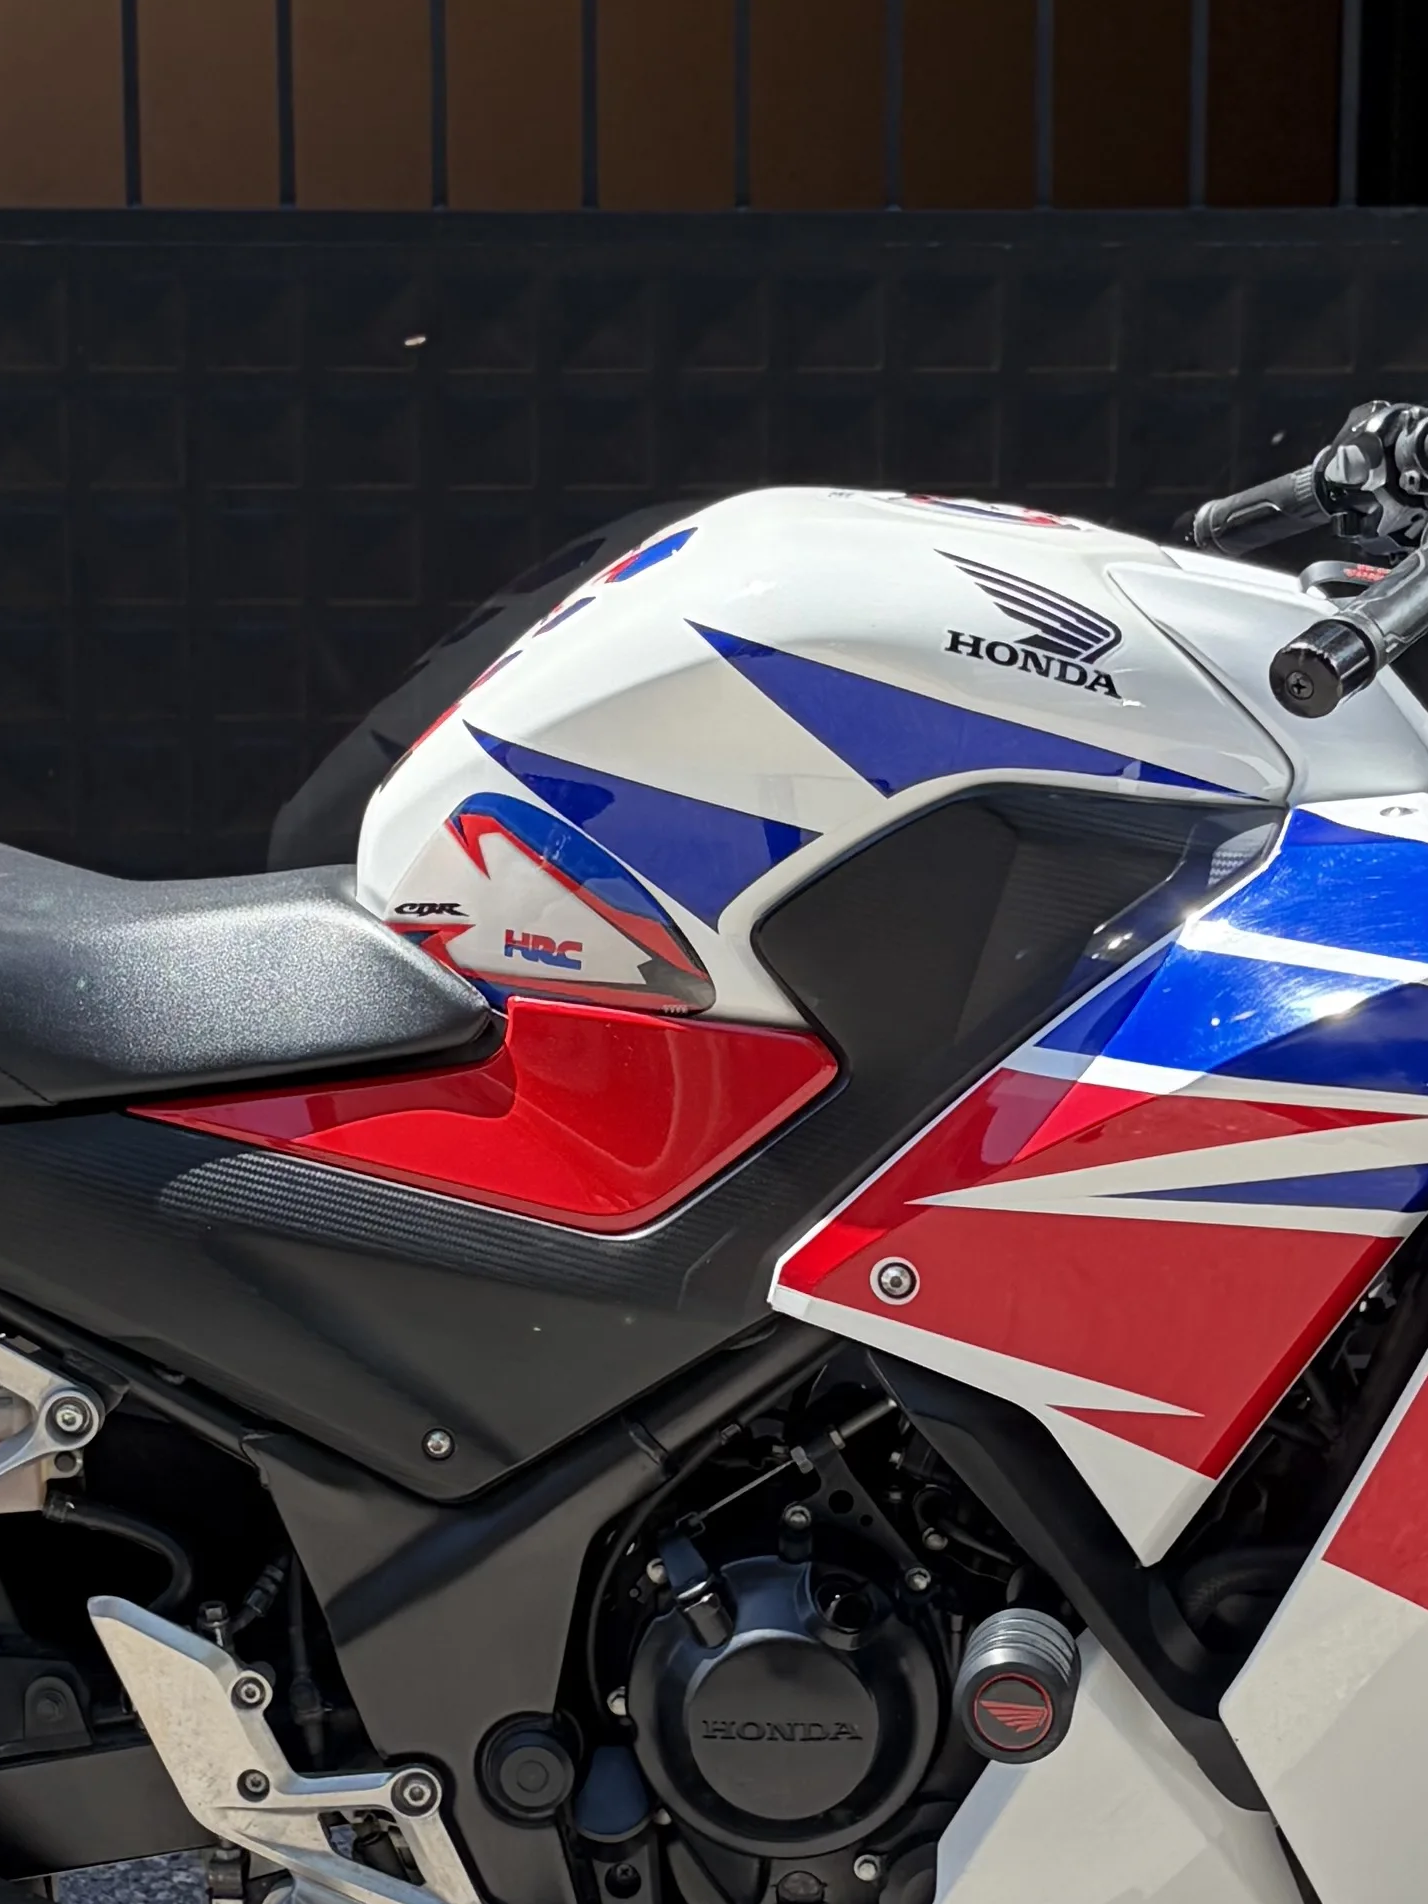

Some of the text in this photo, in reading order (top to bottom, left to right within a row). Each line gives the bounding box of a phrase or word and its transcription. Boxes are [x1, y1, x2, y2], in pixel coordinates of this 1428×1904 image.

[945, 630, 1122, 699] HONDA
[394, 902, 470, 917] CBR
[504, 929, 583, 971] HRC
[702, 1720, 863, 1742] HONDA
